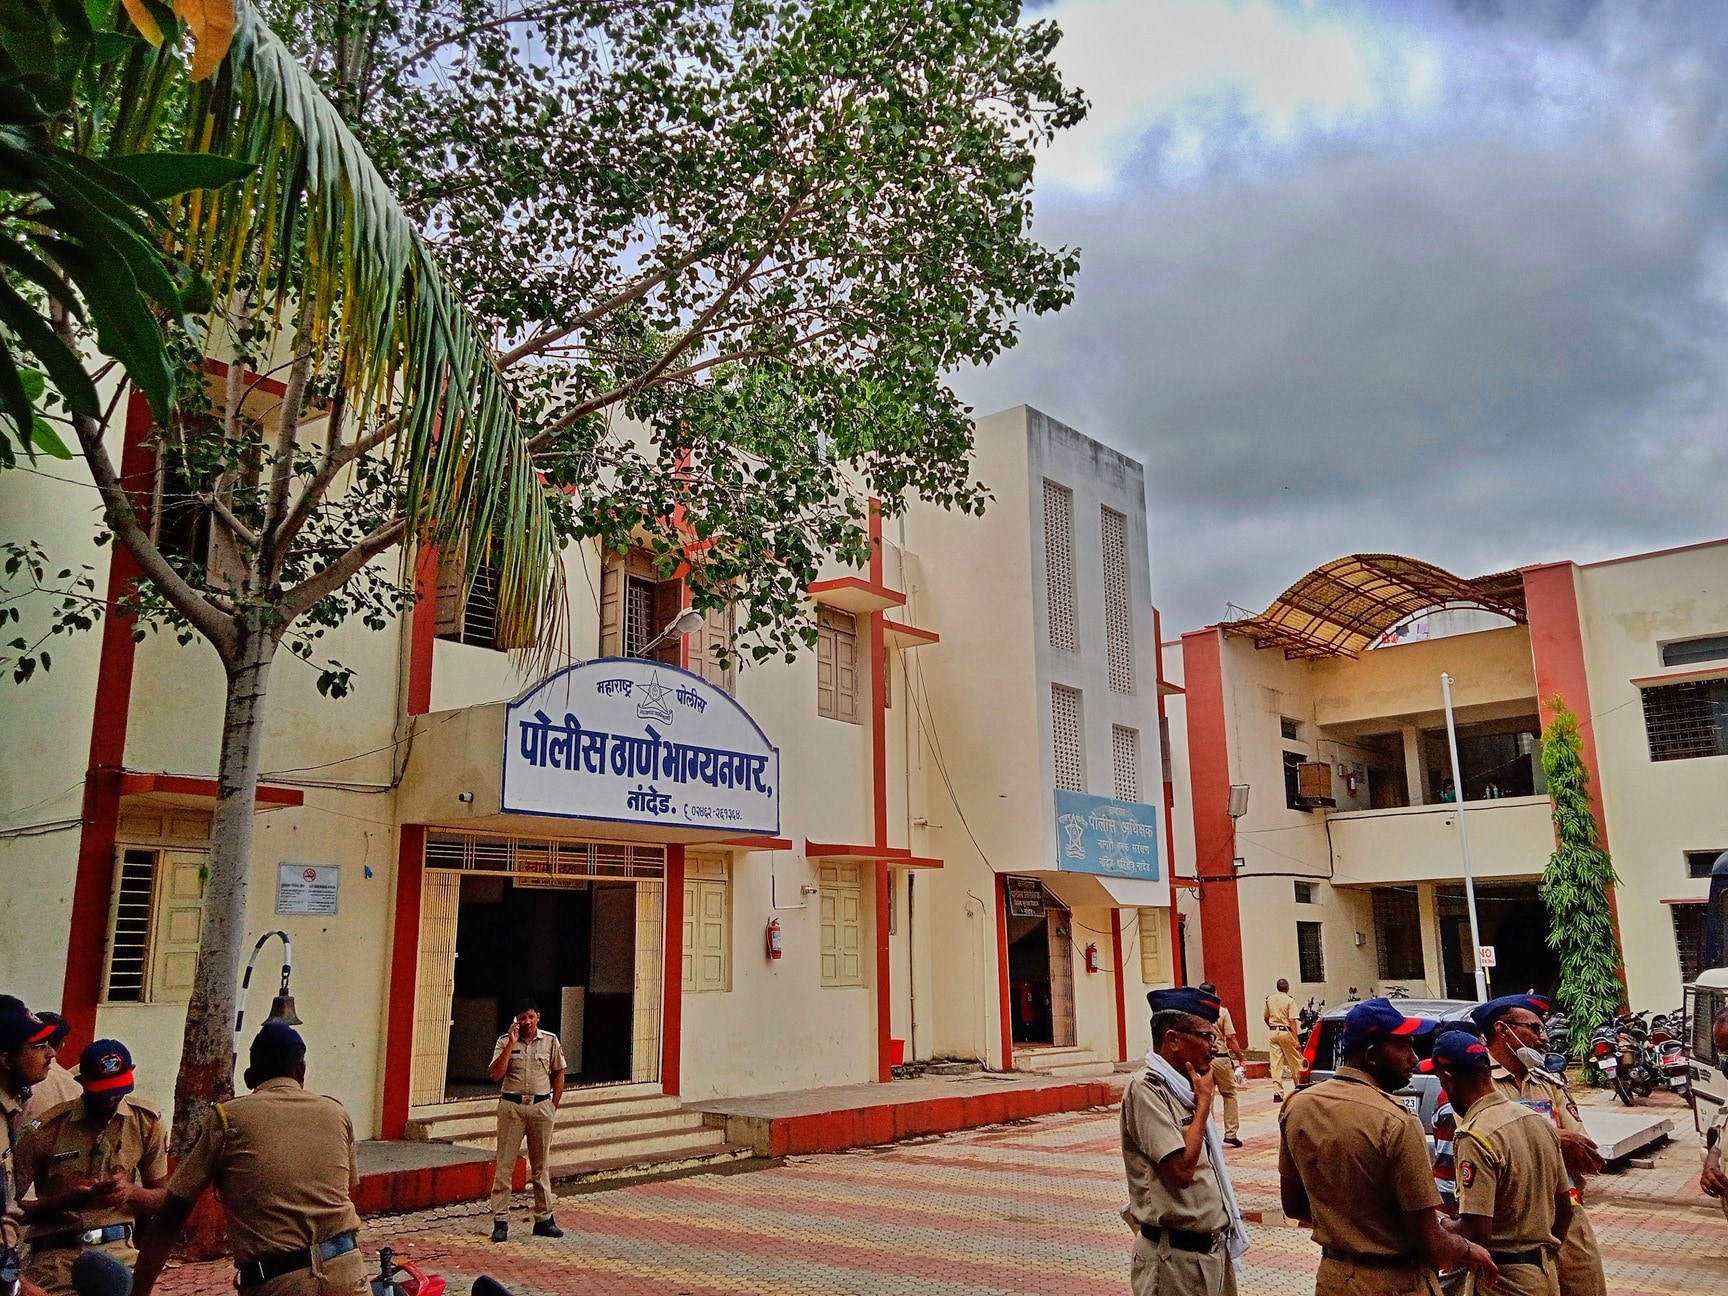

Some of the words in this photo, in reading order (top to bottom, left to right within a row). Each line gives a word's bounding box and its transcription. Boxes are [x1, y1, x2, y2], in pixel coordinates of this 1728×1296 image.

[596, 678, 634, 698] महाराष्ट्र
[676, 684, 707, 714] पोलीस
[519, 709, 609, 775] पोलीस
[610, 724, 662, 780] ठाणे
[662, 741, 773, 798] भाग्यनगर,
[627, 784, 677, 816] नांदेड.
[1088, 811, 1116, 833] पोलीस
[1479, 948, 1491, 957] NO
[1402, 1099, 1415, 1108] 23
